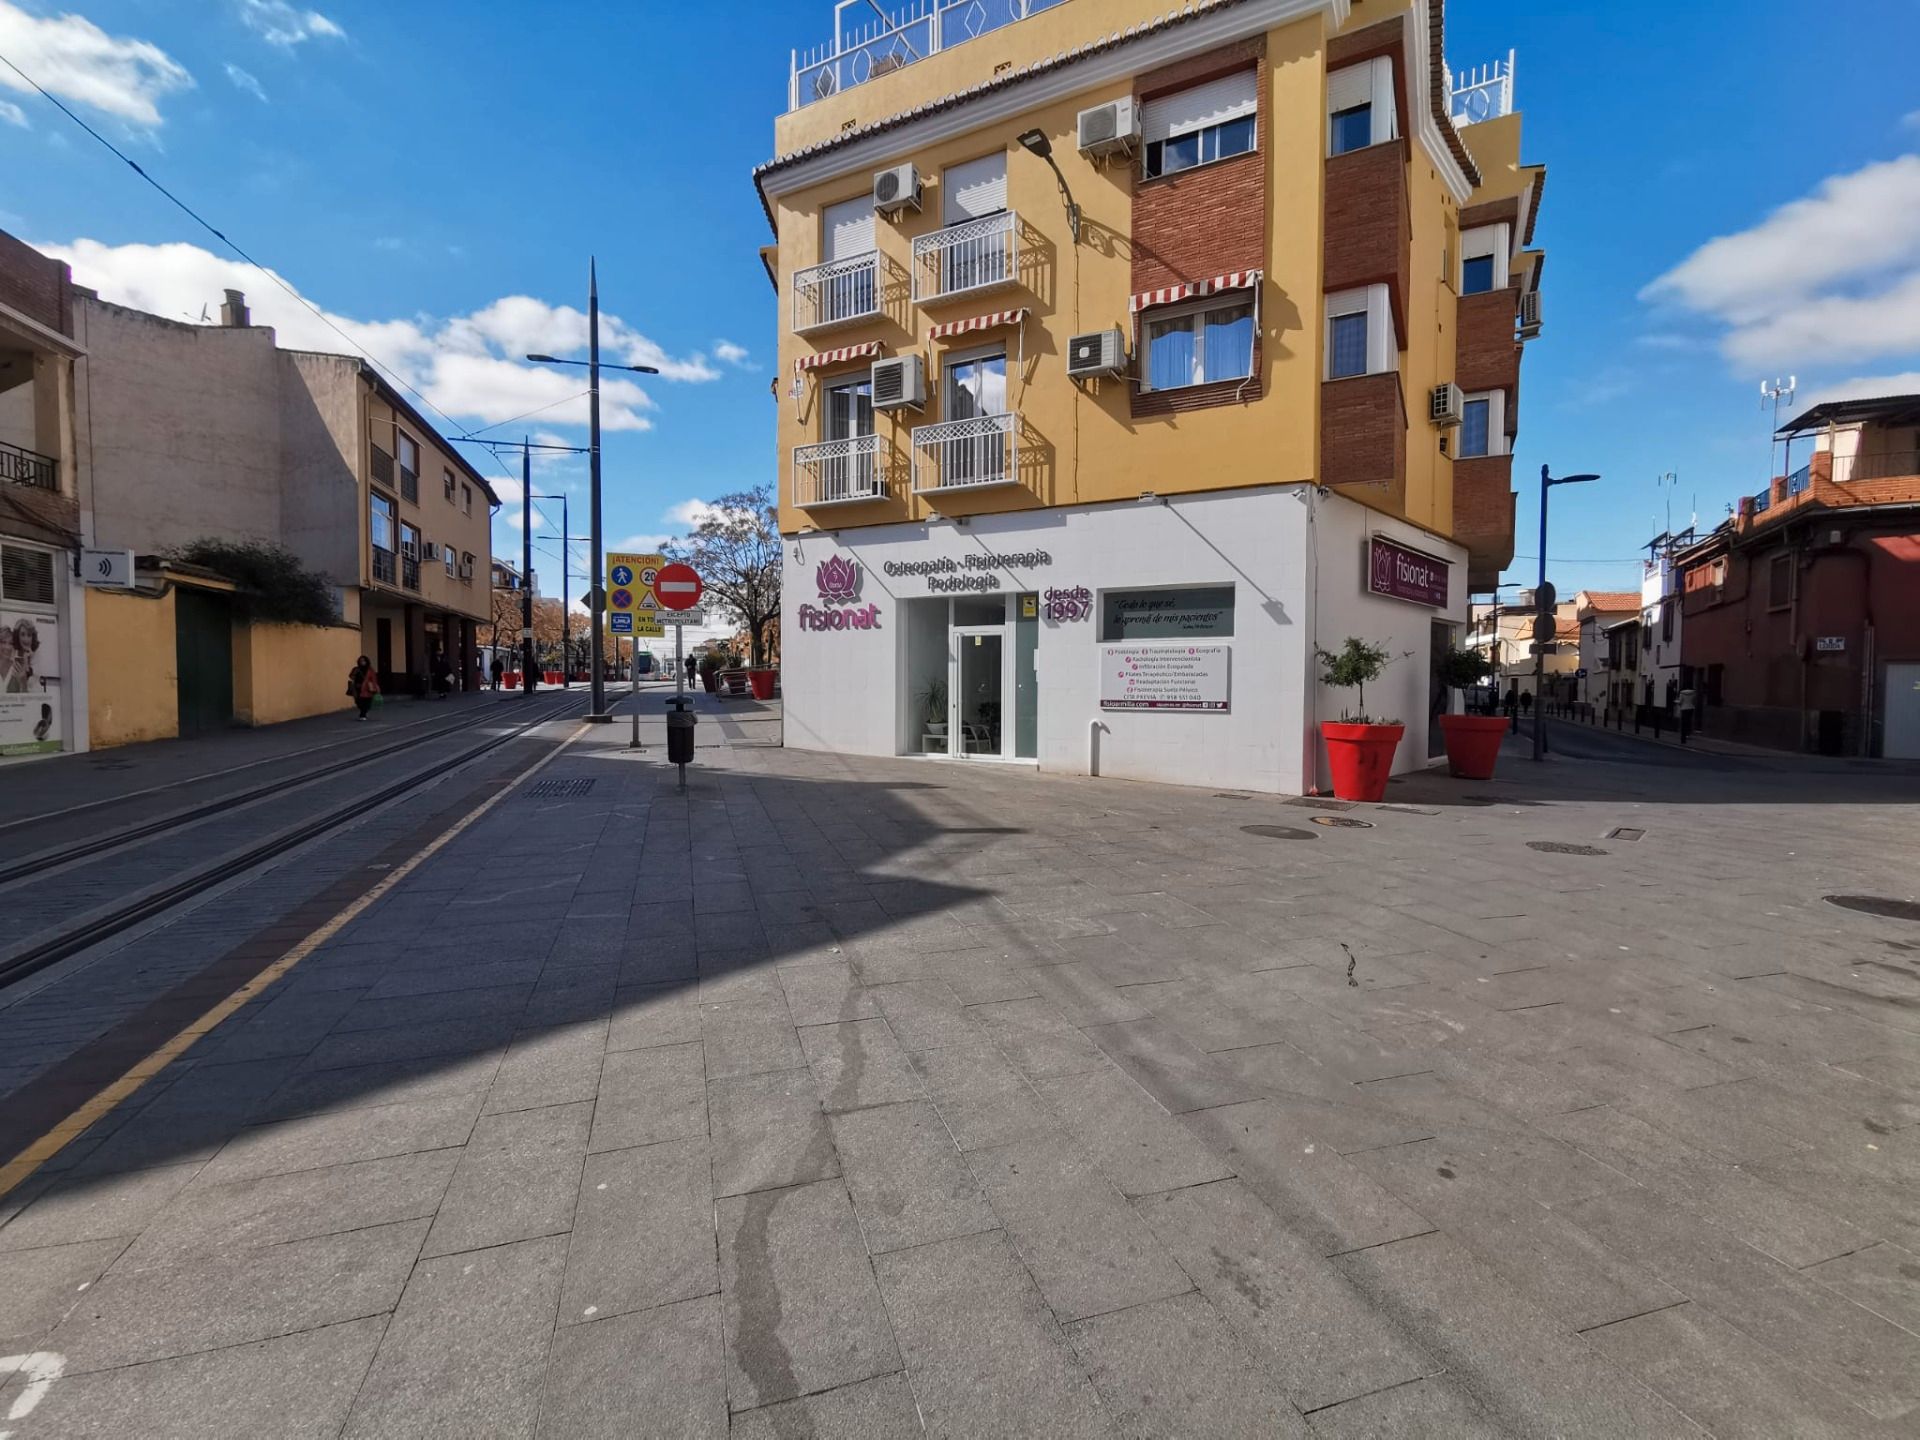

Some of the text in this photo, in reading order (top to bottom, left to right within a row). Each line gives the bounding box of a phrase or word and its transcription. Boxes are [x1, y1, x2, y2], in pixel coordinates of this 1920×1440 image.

[884, 548, 1051, 577] Osteopatía Fisioterapia
[1396, 552, 1429, 588] fisionat
[644, 571, 656, 582] 20
[927, 572, 1000, 592] Podología
[1044, 585, 1089, 601] desde
[798, 603, 882, 631] fisionat
[1044, 601, 1090, 619] 1997
